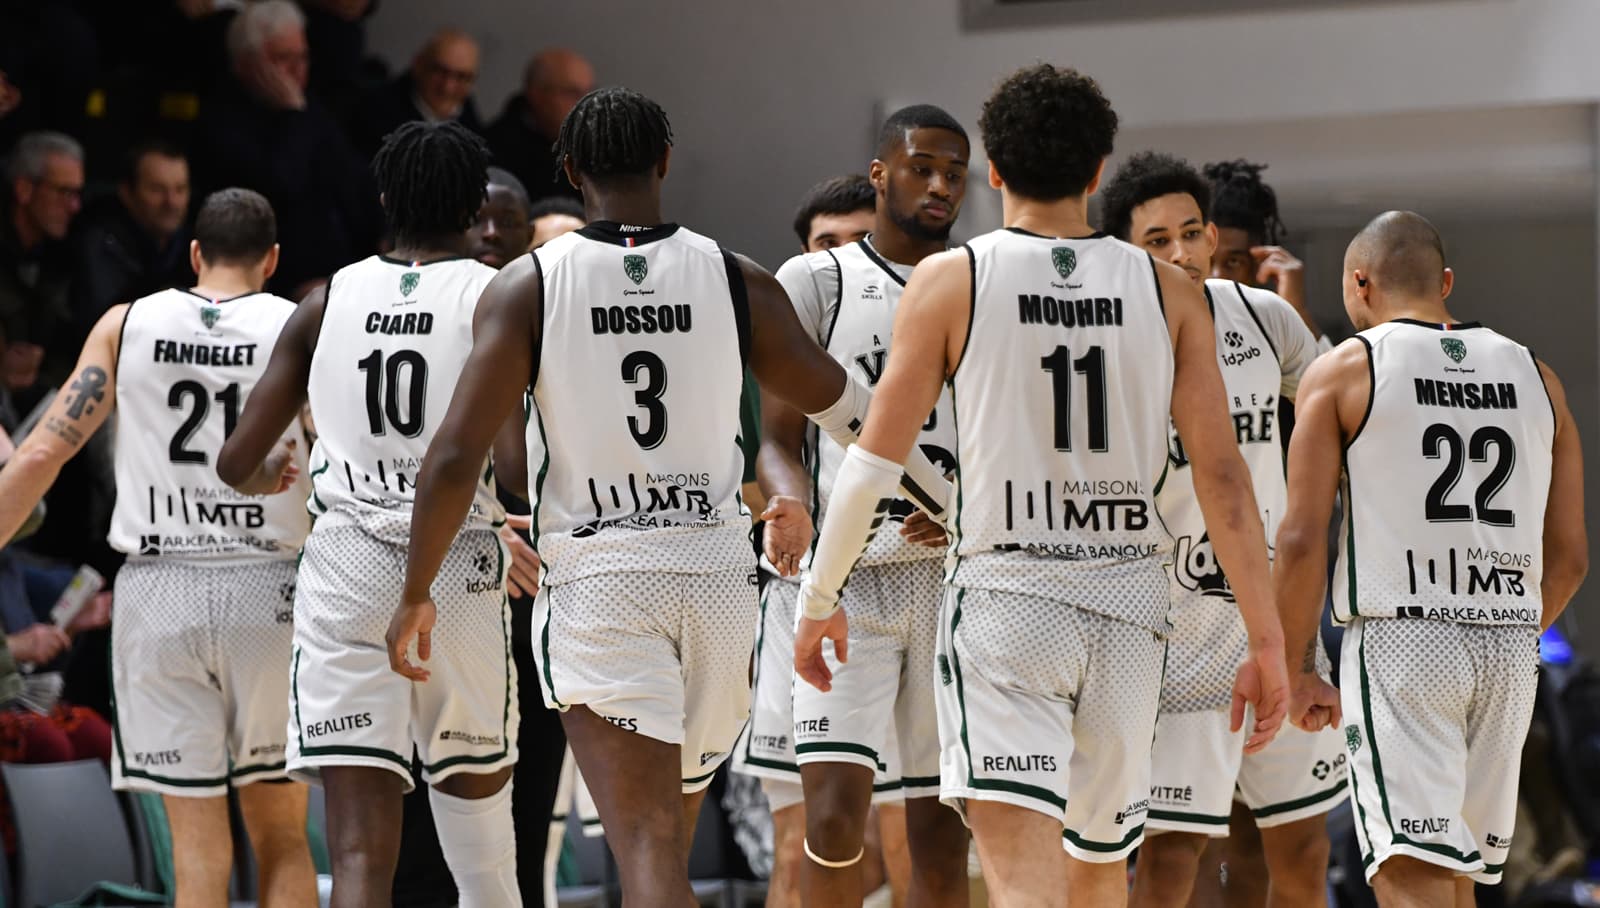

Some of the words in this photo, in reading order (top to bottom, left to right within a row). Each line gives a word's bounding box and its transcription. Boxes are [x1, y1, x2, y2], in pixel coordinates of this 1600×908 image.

[365, 311, 434, 335] CIARD
[591, 303, 692, 335] DOSSOU
[1018, 294, 1123, 328] MOUHRI
[154, 339, 257, 367] FANDELET
[357, 349, 429, 439] 10
[621, 350, 668, 451] 3
[1040, 345, 1109, 453] 11
[1414, 378, 1518, 409] MENSAH
[167, 379, 242, 466] 21
[1422, 423, 1516, 528] 22
[196, 503, 265, 528] MTB
[1063, 499, 1149, 532] MTB
[1427, 606, 1489, 621] ARKEA
[306, 712, 373, 739] REALITES
[983, 755, 1057, 772] REALITES
